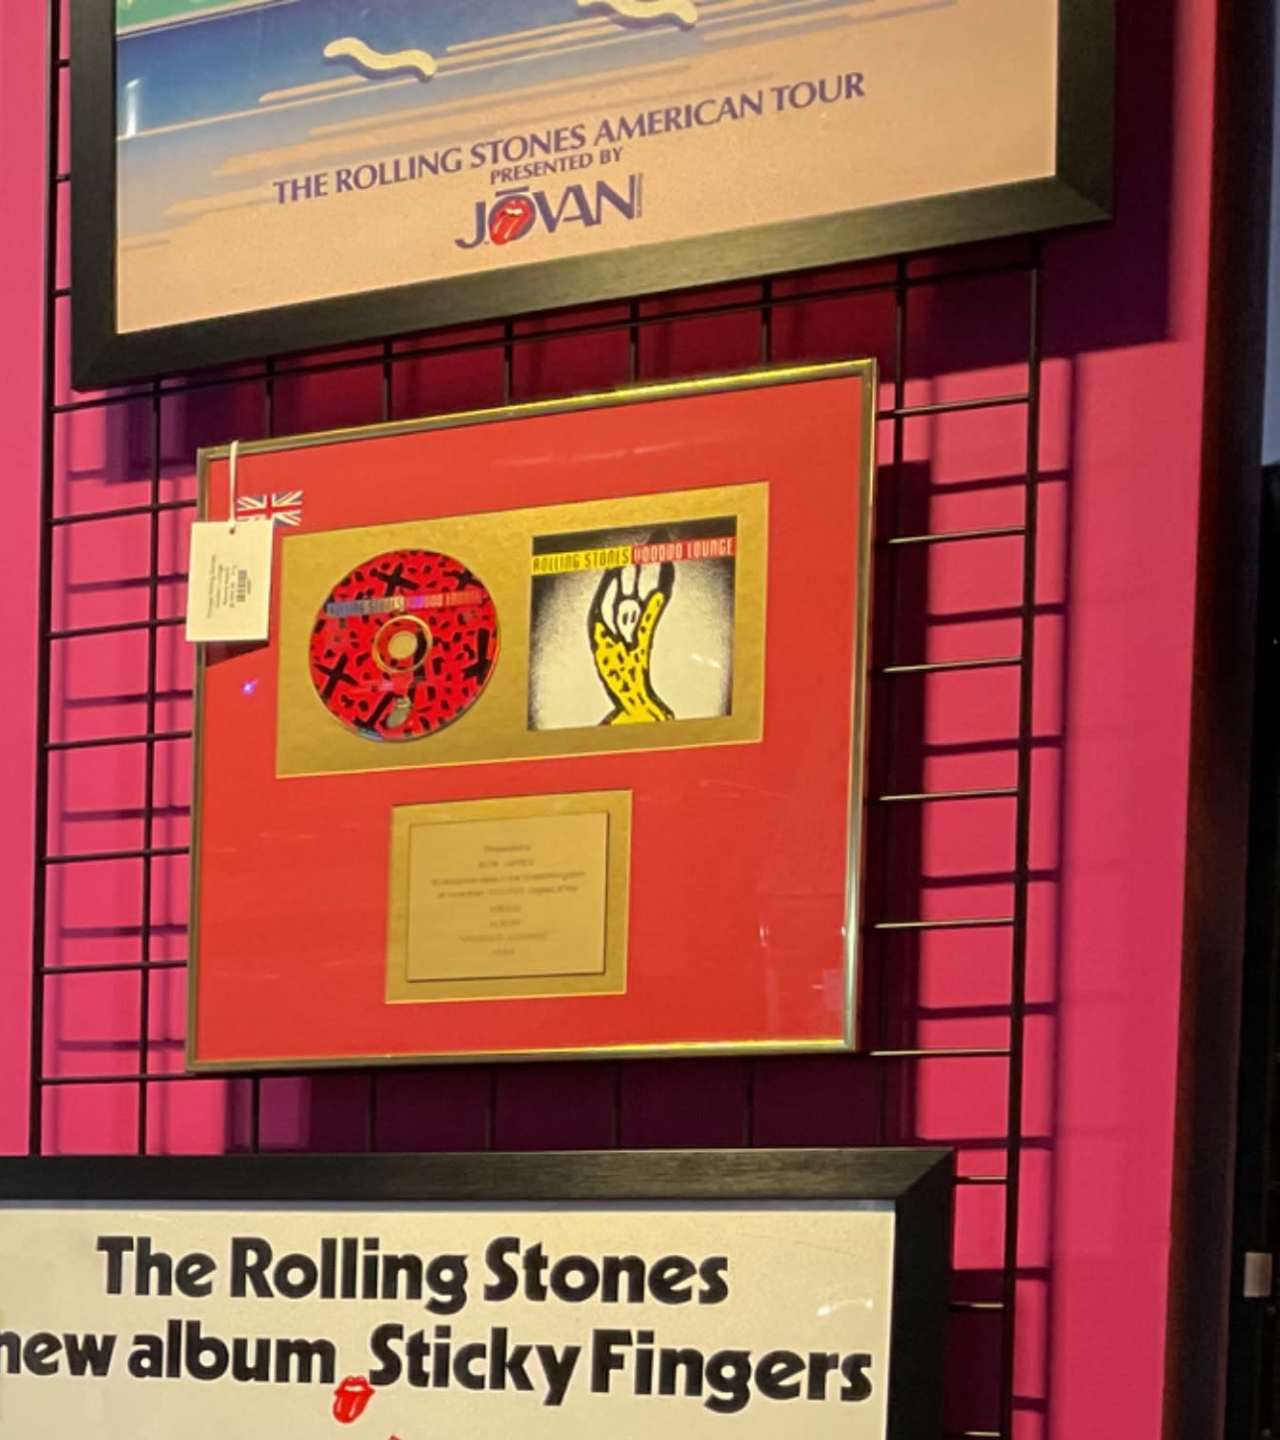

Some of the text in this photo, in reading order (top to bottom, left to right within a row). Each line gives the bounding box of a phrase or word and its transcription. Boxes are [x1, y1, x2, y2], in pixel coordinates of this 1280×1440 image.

[273, 70, 866, 204] THE ROLLING STONES AMERICAN TOUR
[489, 146, 624, 186] PRESENTED BY
[533, 538, 734, 574] ROLLING STONES VOODOO LOUNGE
[97, 1236, 730, 1316] The Rolling Stones
[127, 1320, 338, 1385] album
[369, 1323, 582, 1407] Sticky
[590, 1329, 874, 1414] Fingers
